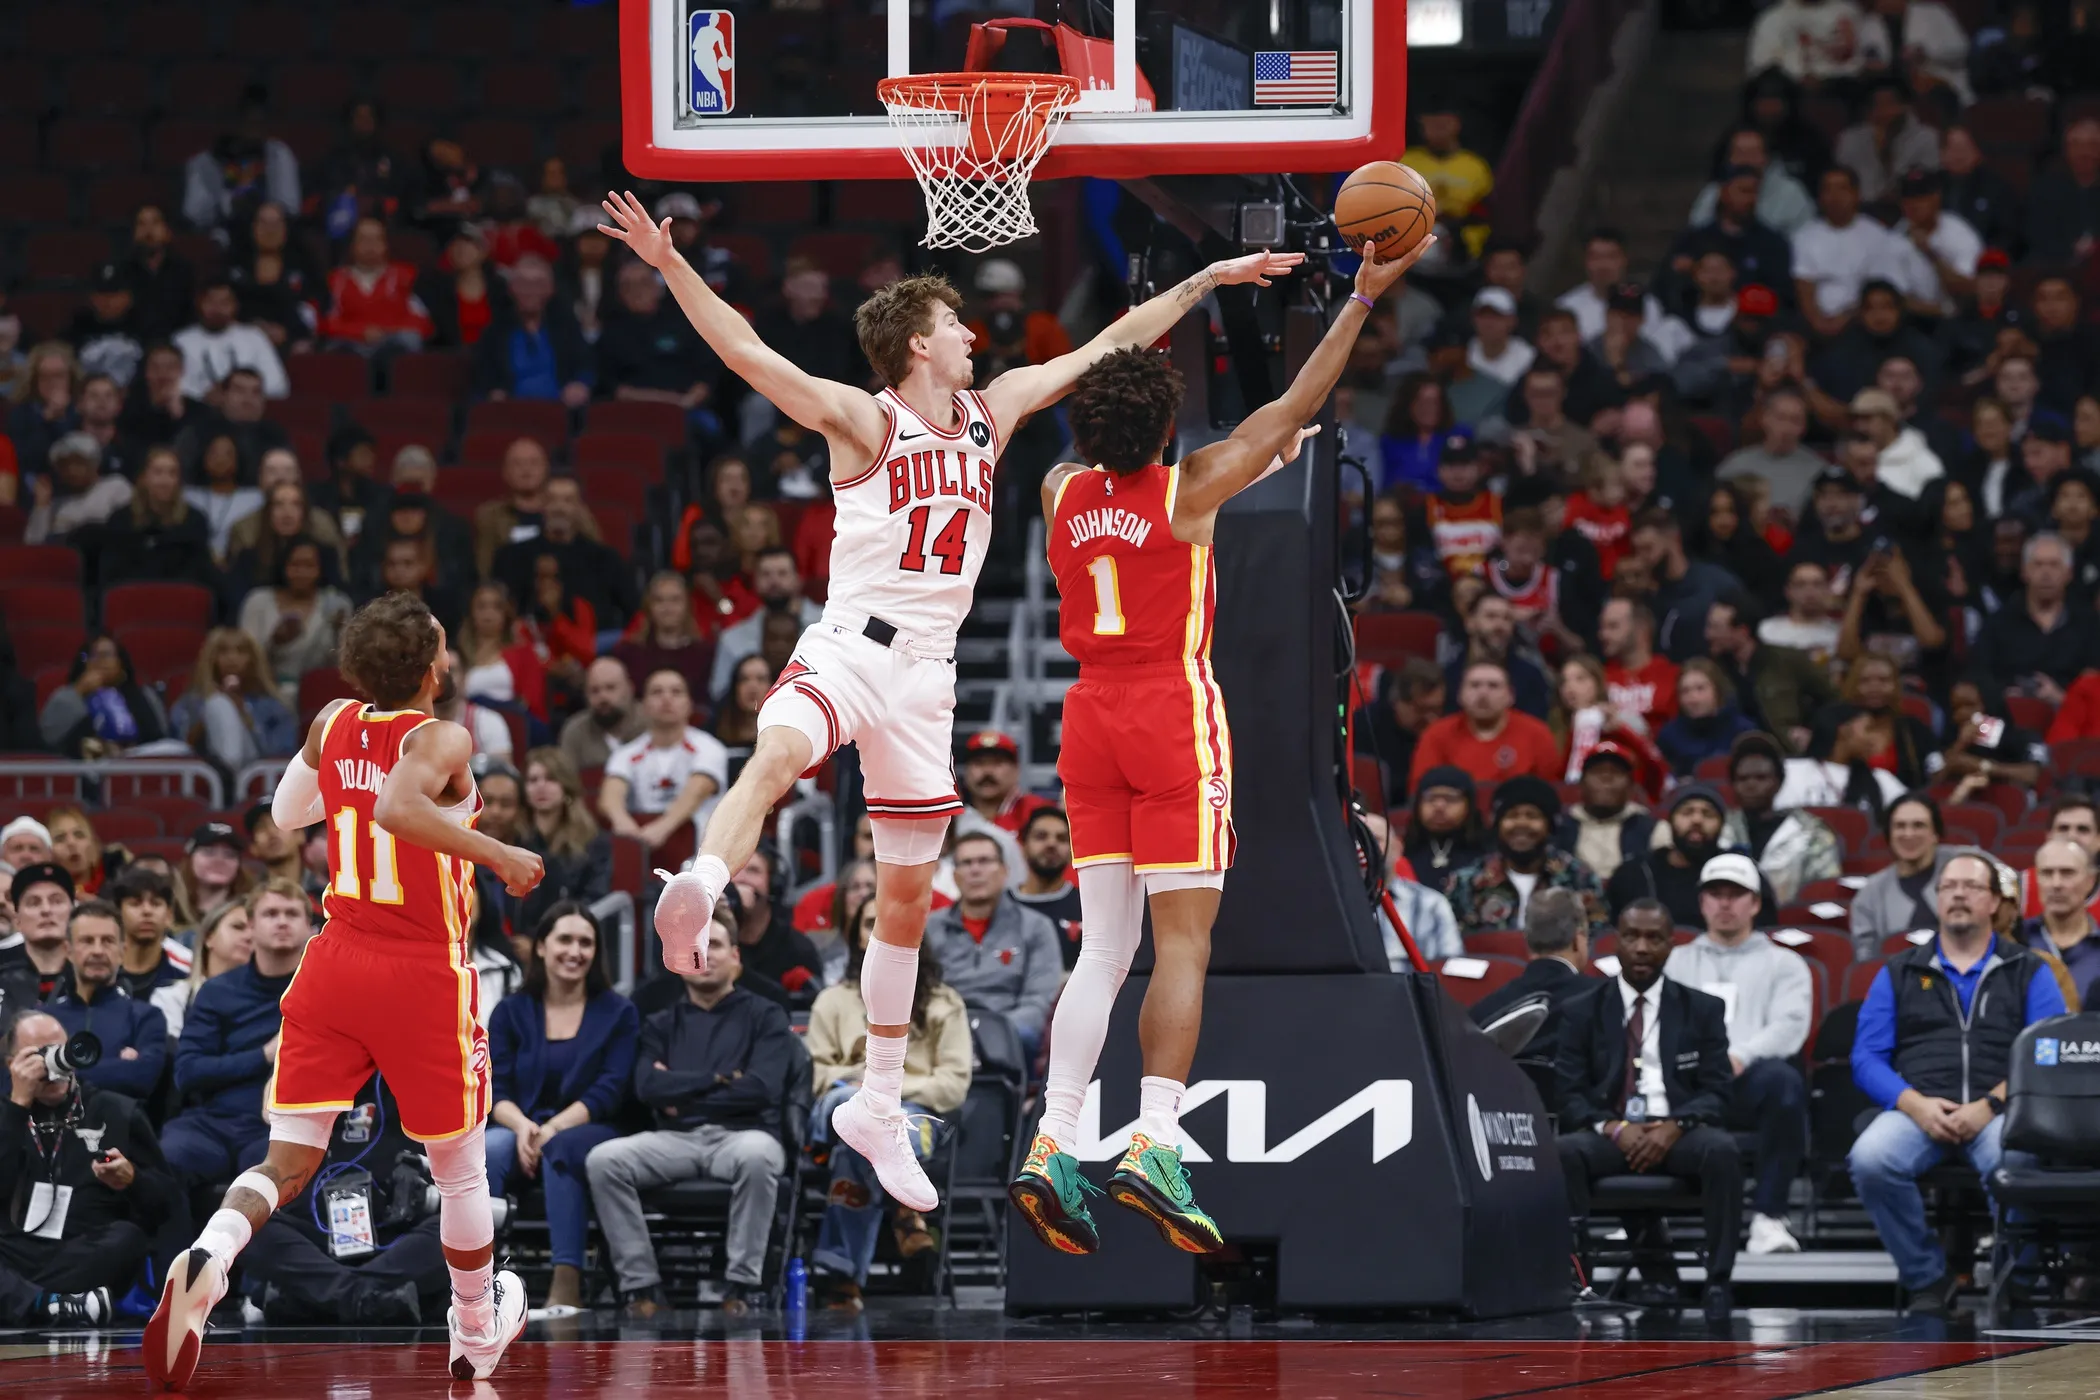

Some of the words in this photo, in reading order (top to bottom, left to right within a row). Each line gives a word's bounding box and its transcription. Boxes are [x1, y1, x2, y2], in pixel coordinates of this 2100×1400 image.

[696, 91, 718, 108] NBA
[887, 450, 992, 516] BULLS
[899, 506, 970, 576] 14
[1066, 507, 1152, 549] JOHNSON
[1086, 554, 1126, 636] 1
[333, 805, 405, 906] 11
